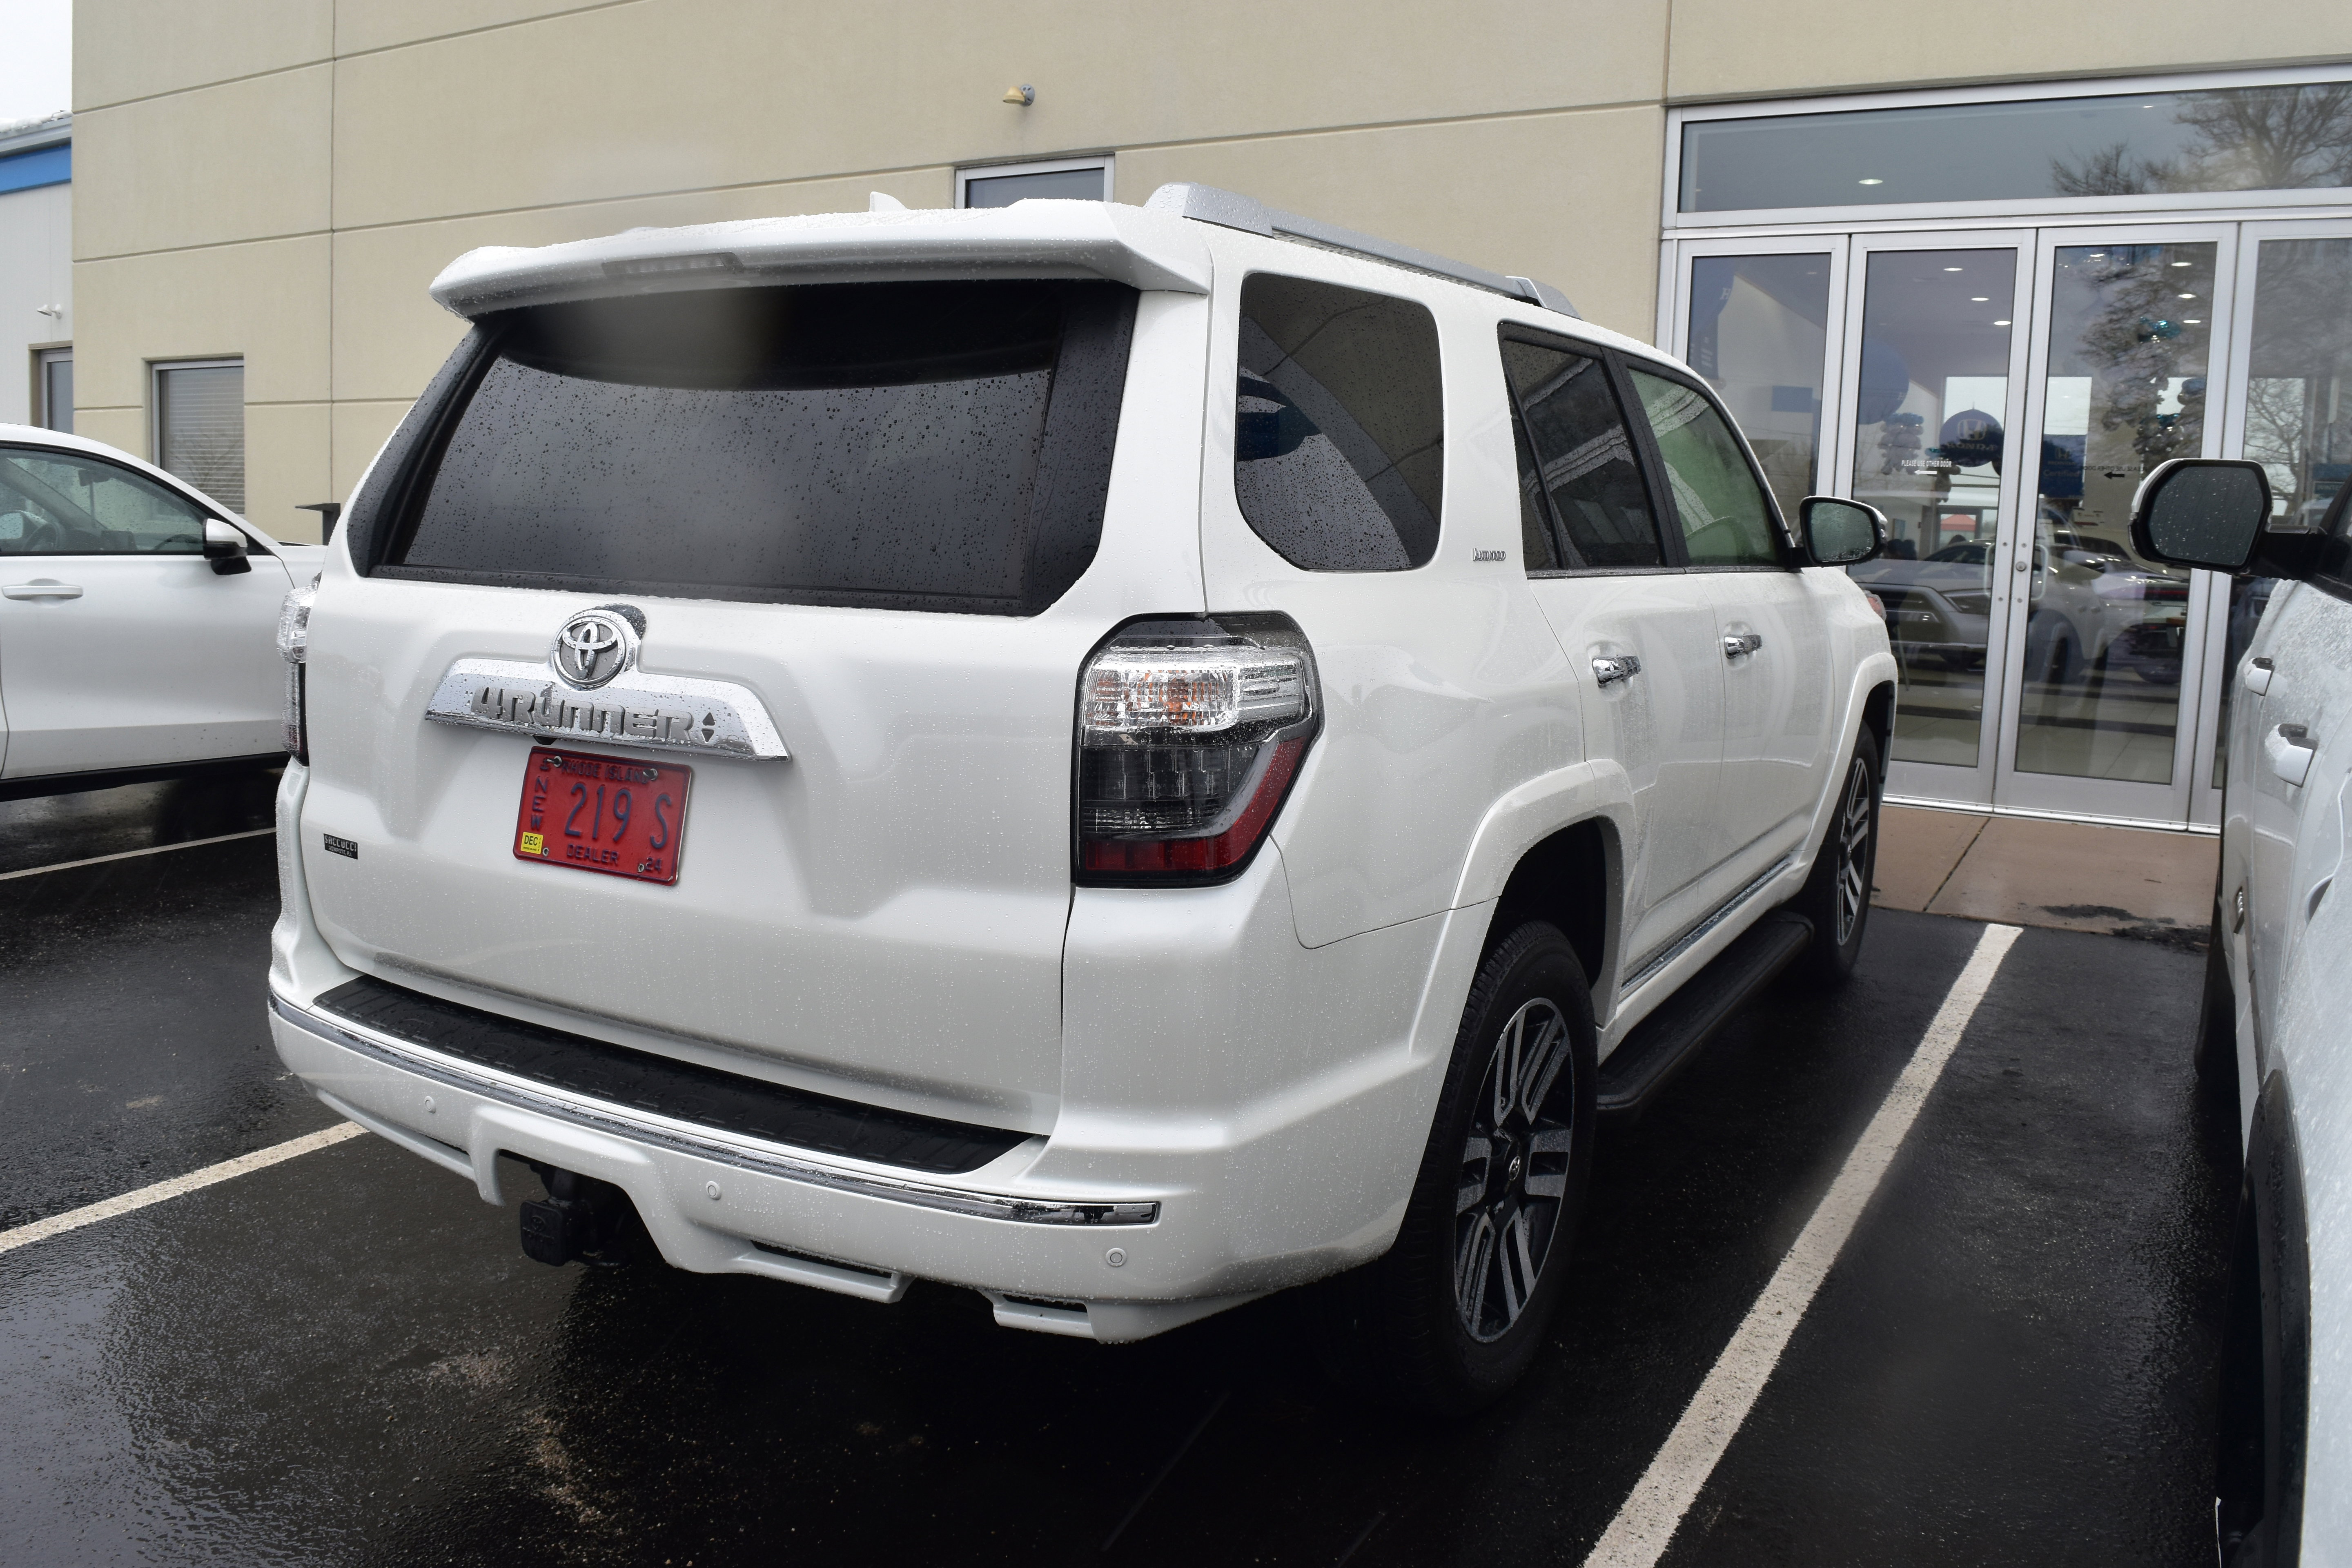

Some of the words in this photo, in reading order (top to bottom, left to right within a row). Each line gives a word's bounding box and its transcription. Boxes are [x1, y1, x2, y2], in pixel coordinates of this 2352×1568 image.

[561, 760, 601, 778] RHODE
[565, 783, 632, 842] 219
[650, 794, 672, 849] S
[324, 835, 356, 852] SACCUCCI
[524, 835, 538, 846] DEC
[566, 843, 618, 864] DEALER
[645, 857, 662, 871] 24
